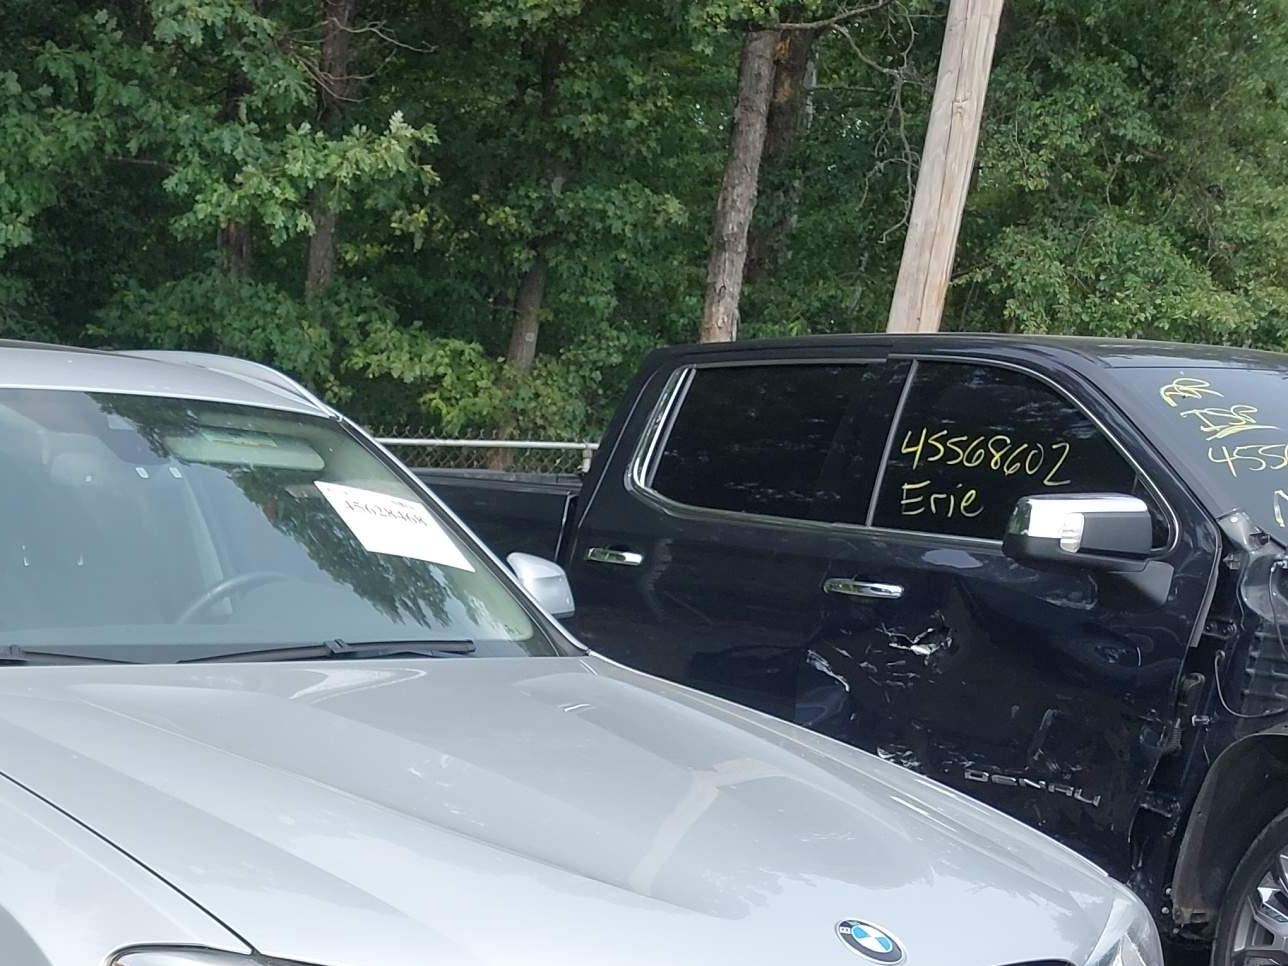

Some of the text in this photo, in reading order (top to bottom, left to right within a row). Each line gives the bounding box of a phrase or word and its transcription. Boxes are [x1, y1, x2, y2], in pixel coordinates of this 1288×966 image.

[900, 426, 1072, 487] 45568602
[1207, 443, 1288, 479] 455
[899, 480, 985, 518] Erie
[964, 769, 1101, 807] DENALI
